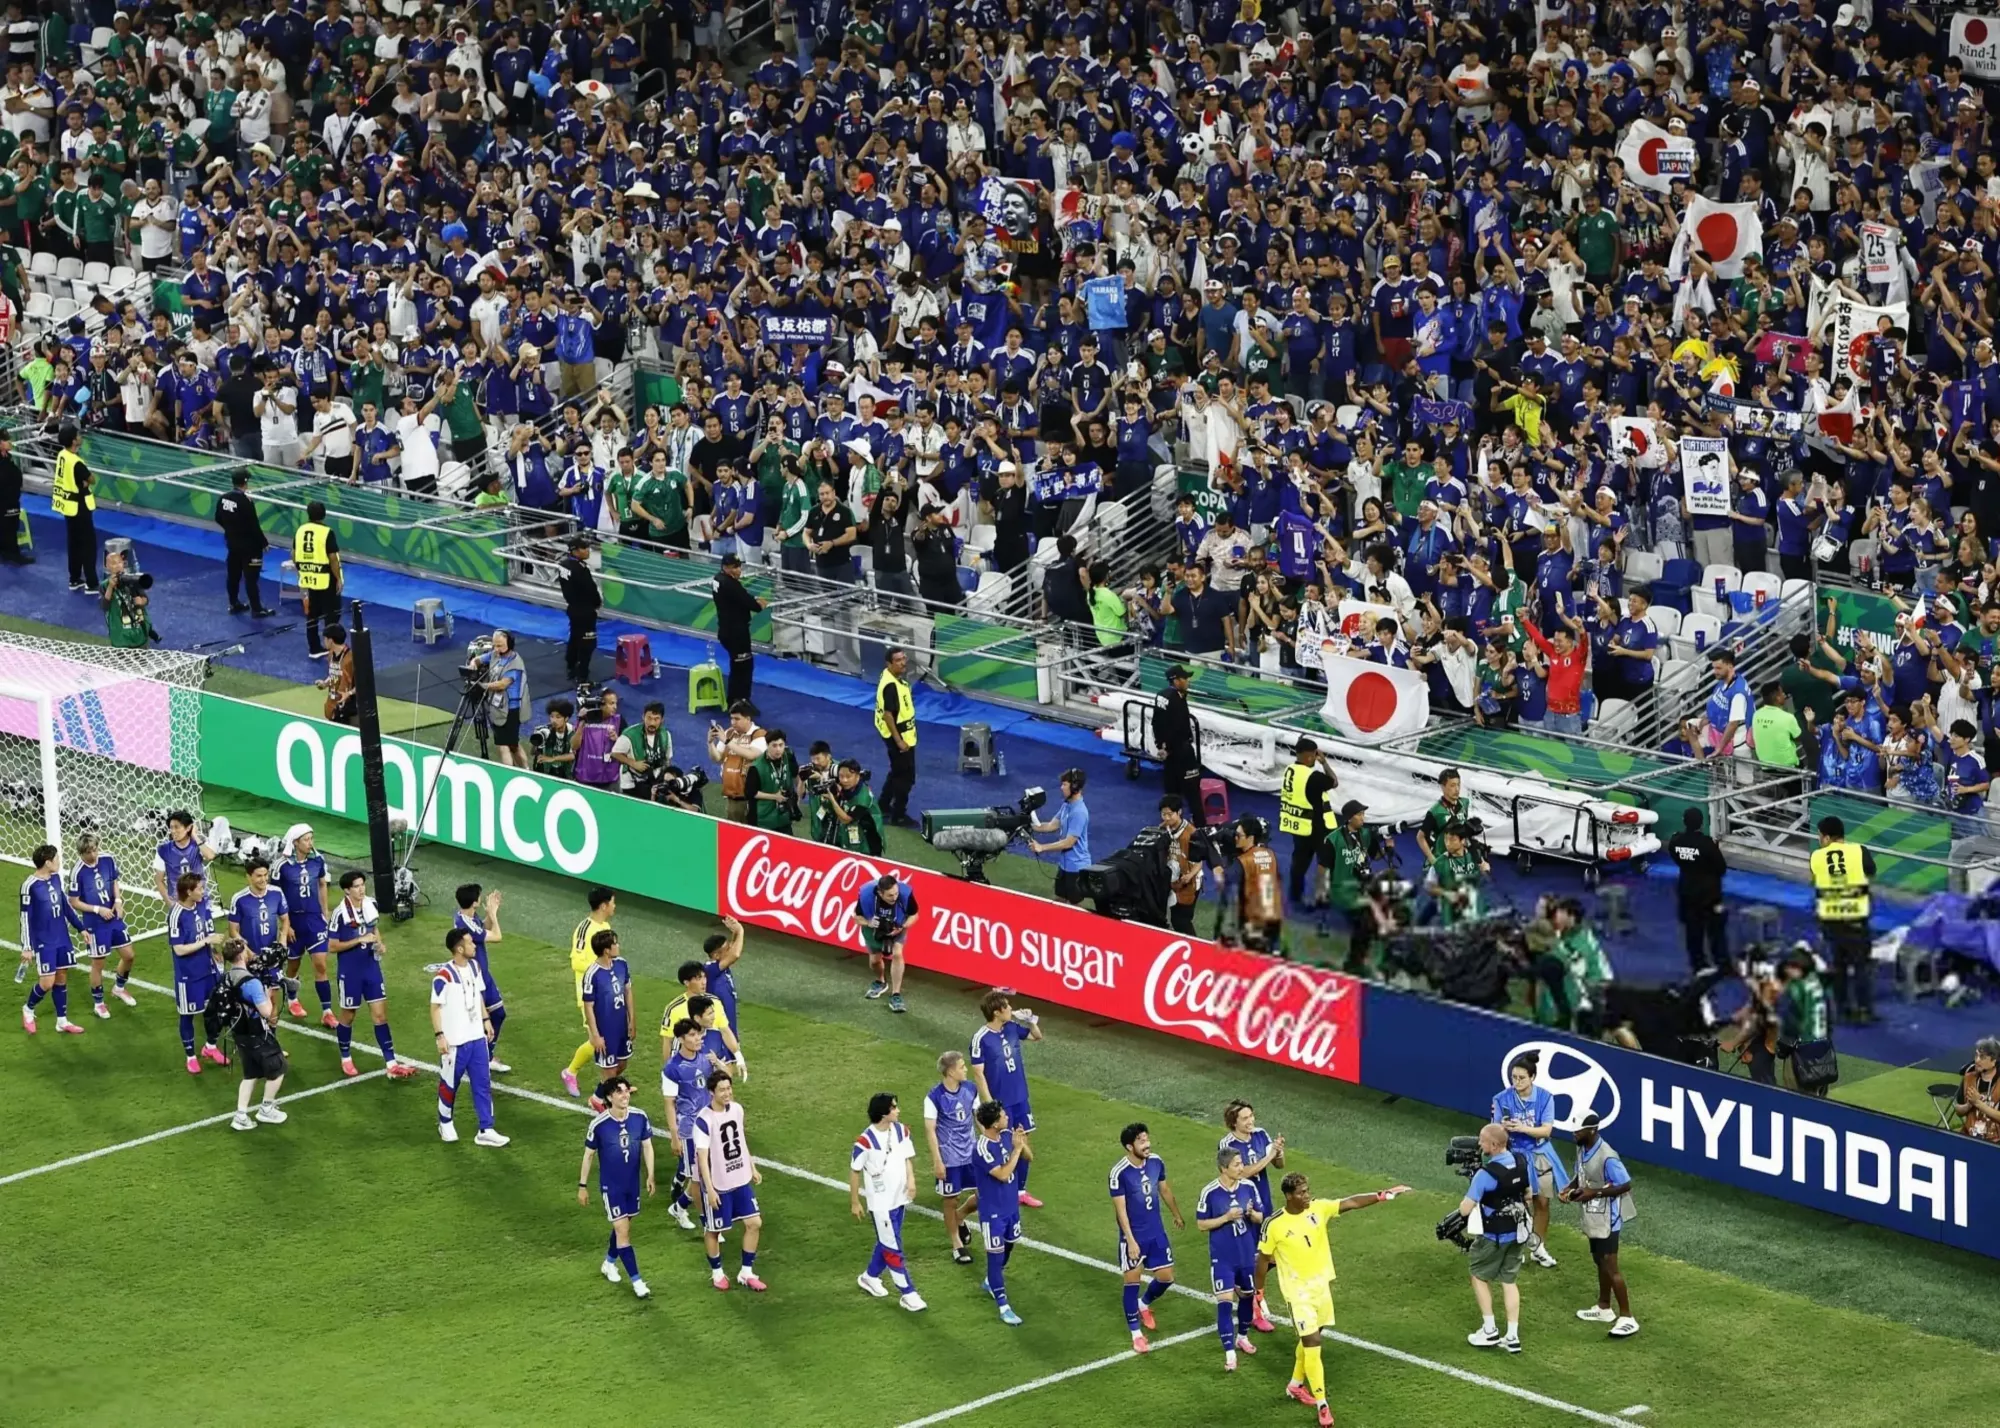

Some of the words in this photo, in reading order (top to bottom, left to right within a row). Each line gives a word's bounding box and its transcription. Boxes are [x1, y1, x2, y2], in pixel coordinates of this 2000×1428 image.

[1976, 60, 1996, 70] With
[1661, 162, 1689, 171] JAPAN
[1867, 234, 1885, 257] 25
[766, 316, 827, 333] 長友佑都
[1883, 348, 1896, 375] 5
[1084, 390, 1090, 401] 7
[729, 420, 740, 432] 15
[791, 427, 801, 439] 18
[1683, 440, 1724, 451] WATANABE
[1293, 531, 1305, 558] 4
[276, 721, 599, 874] aramco
[1283, 817, 1299, 831] 918
[98, 889, 110, 905] 14
[299, 885, 311, 898] 21
[727, 834, 912, 947] Coca-Co
[52, 904, 60, 918] 17
[260, 923, 270, 936] 16
[931, 904, 1013, 960] zero
[1020, 928, 1123, 991] sugar
[613, 995, 625, 1010] 24
[1144, 940, 1351, 1069] Coca-Cola
[1005, 1059, 1016, 1073] 19
[622, 1149, 630, 1163] 7
[1641, 1077, 1968, 1228] HYUNDAI
[1145, 1196, 1153, 1210] 2
[1303, 1234, 1312, 1248] 1
